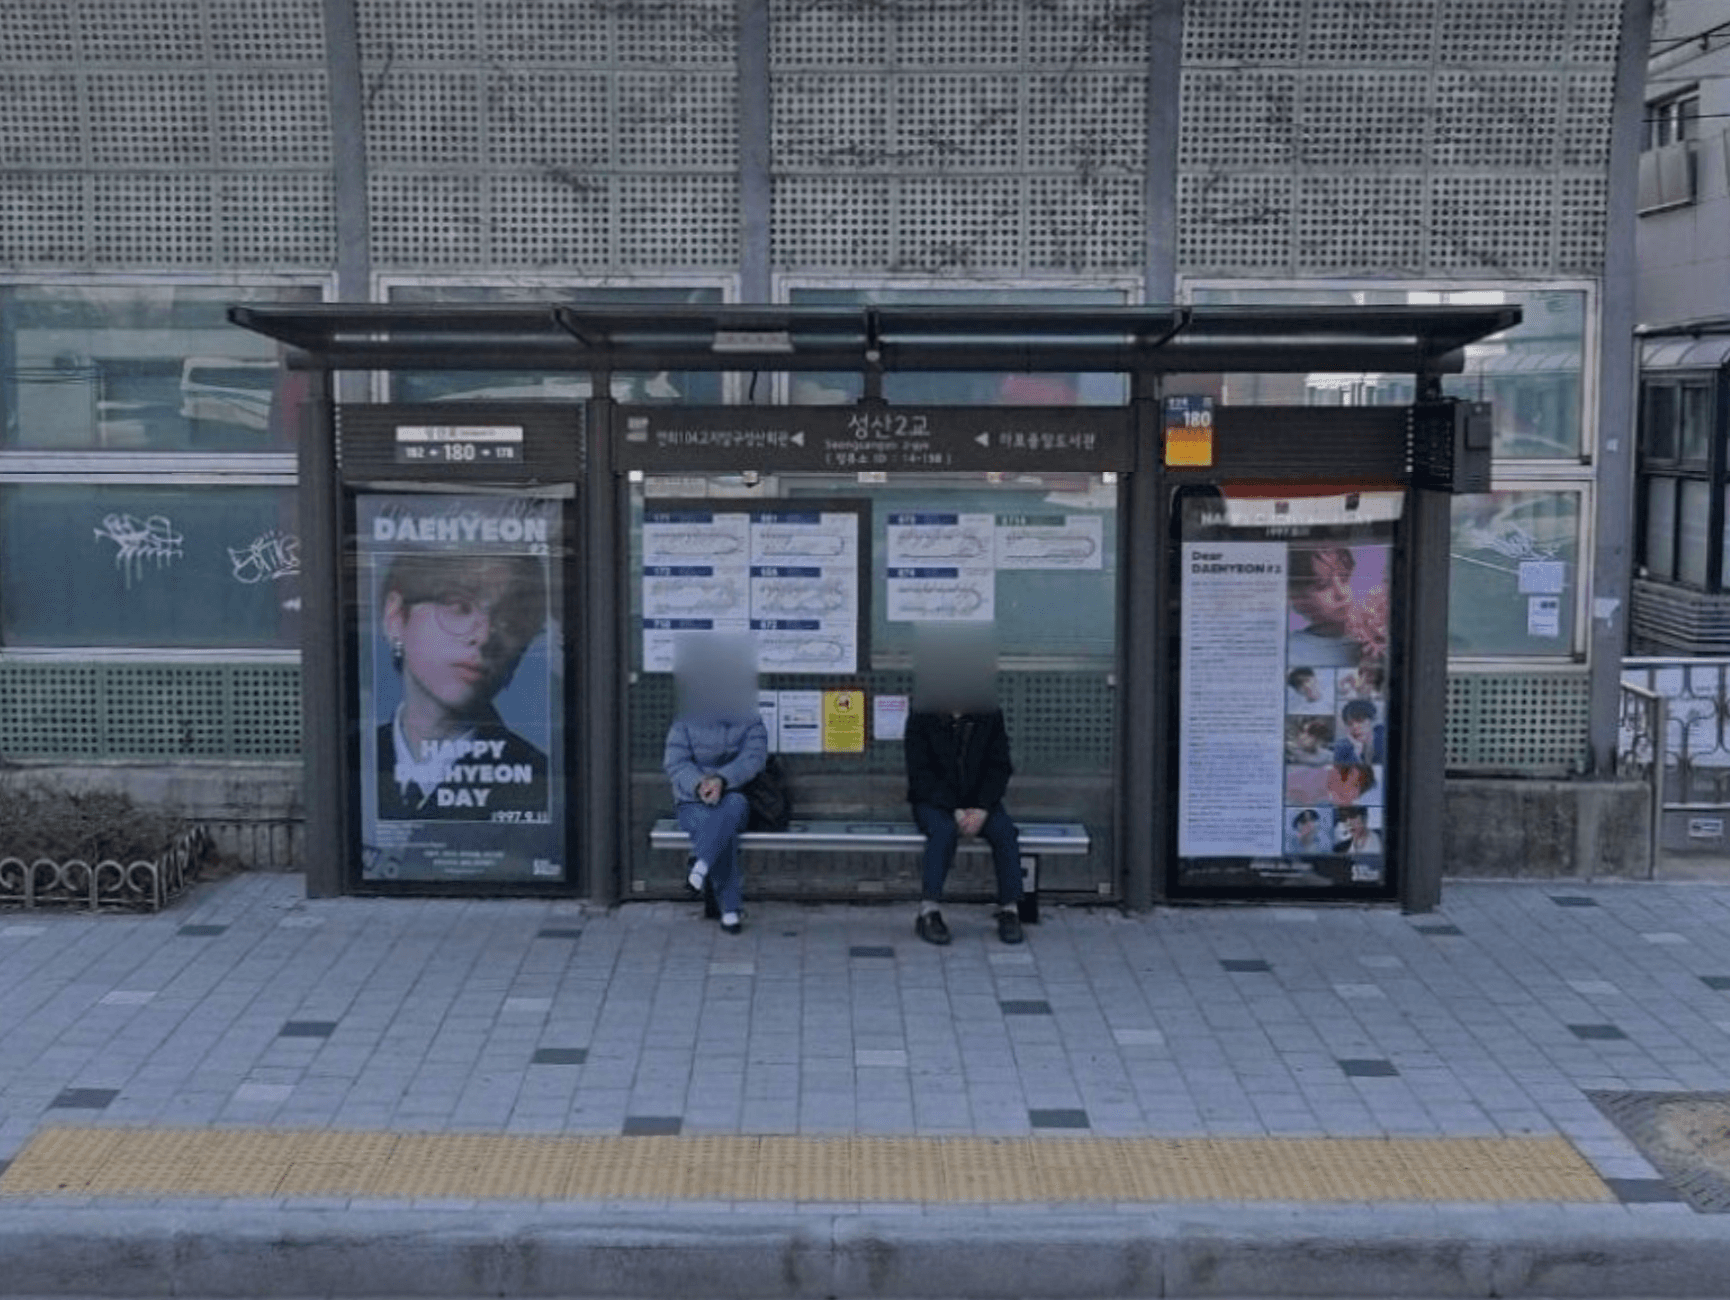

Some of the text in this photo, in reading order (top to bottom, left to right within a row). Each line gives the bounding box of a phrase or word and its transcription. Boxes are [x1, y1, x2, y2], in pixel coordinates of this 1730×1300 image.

[848, 413, 931, 439] 성산2교
[1183, 410, 1212, 427] 180
[443, 443, 476, 461] 180
[373, 517, 548, 542] DAEHYEON
[1191, 551, 1223, 562] Dear
[1191, 563, 1265, 575] DAEHYEON
[420, 739, 506, 759] HAPPY
[437, 788, 491, 808] DAY
